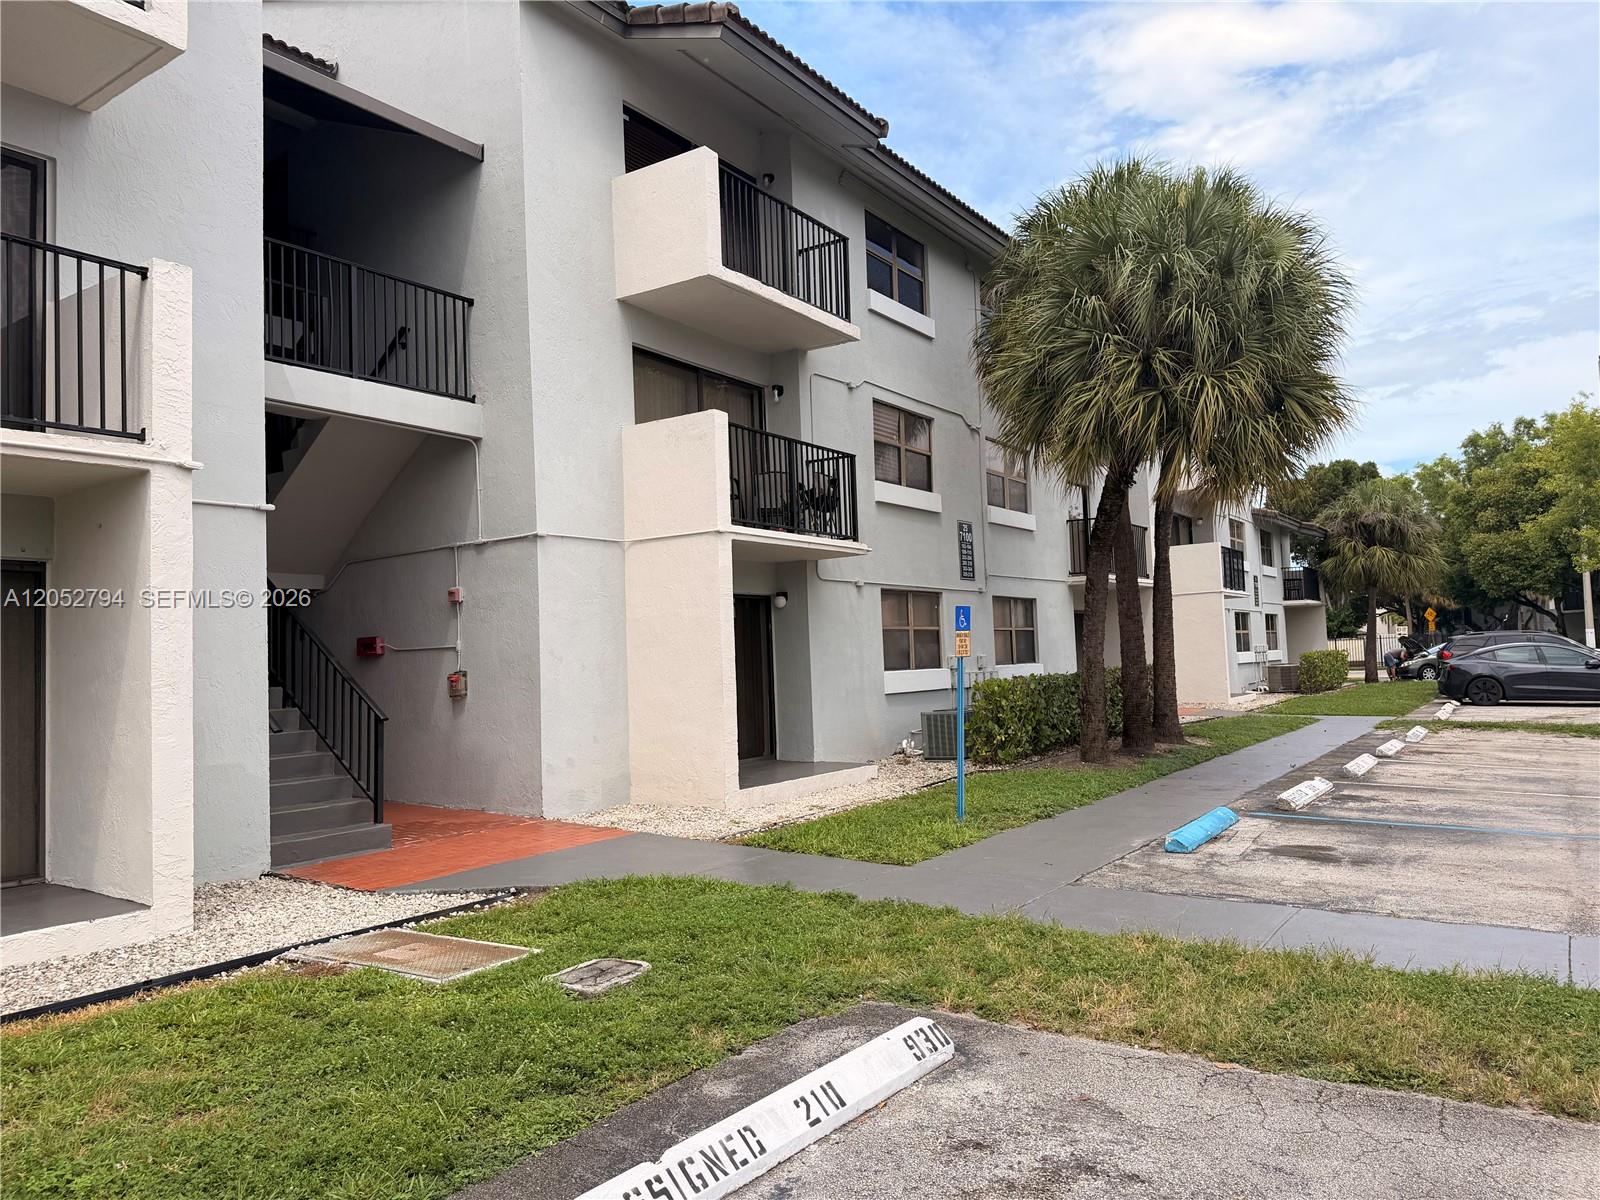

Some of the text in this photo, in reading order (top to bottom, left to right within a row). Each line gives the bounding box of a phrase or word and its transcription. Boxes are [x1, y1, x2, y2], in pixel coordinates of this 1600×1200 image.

[960, 531, 973, 543] 7100
[793, 1080, 847, 1128] 210
[903, 1022, 951, 1062] 930
